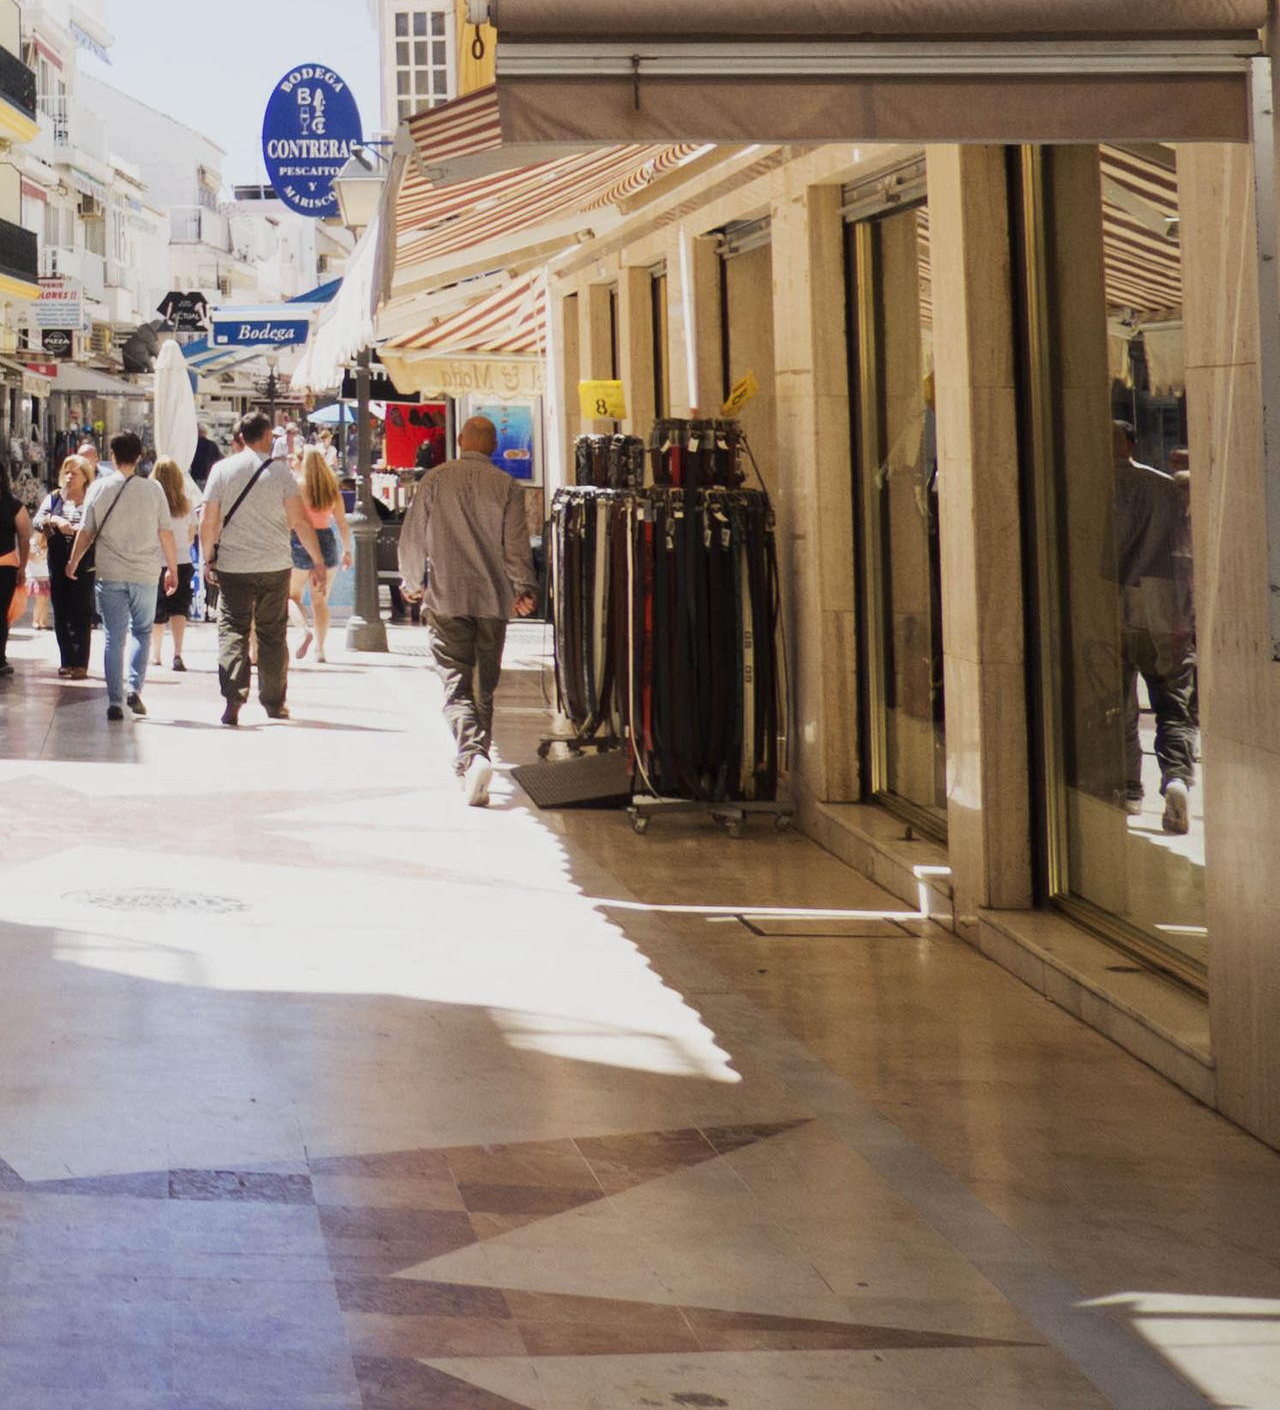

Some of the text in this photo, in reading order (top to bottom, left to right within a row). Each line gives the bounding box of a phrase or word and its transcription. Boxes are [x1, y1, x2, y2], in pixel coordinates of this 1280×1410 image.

[280, 67, 345, 94] BODEGA
[279, 166, 341, 176] PESCAITO
[308, 182, 317, 191] Y
[283, 186, 337, 208] MARISCO
[238, 322, 296, 340] Bodega
